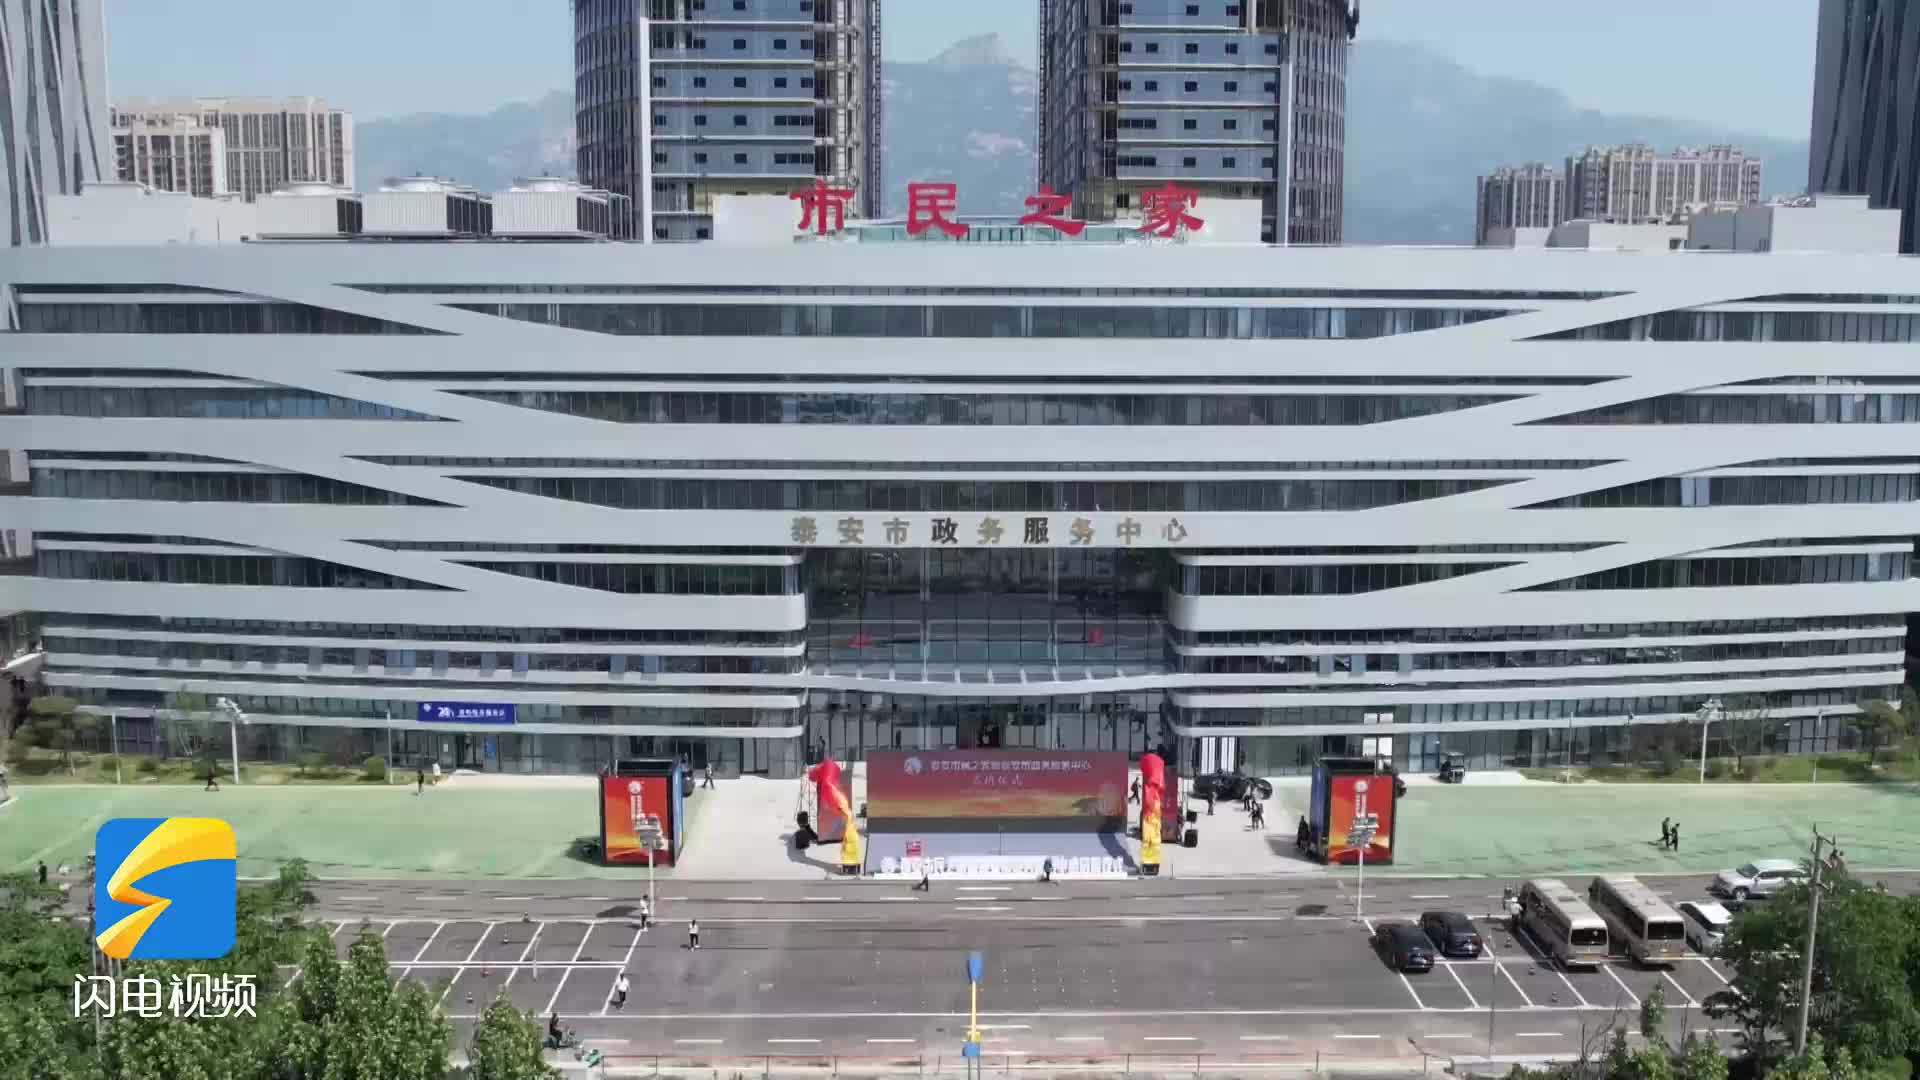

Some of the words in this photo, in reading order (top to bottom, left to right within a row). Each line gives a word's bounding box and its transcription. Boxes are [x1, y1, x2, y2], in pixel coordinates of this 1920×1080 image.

[789, 179, 1205, 239] 市民之家
[791, 517, 1188, 544] 泰安市政务服务中心
